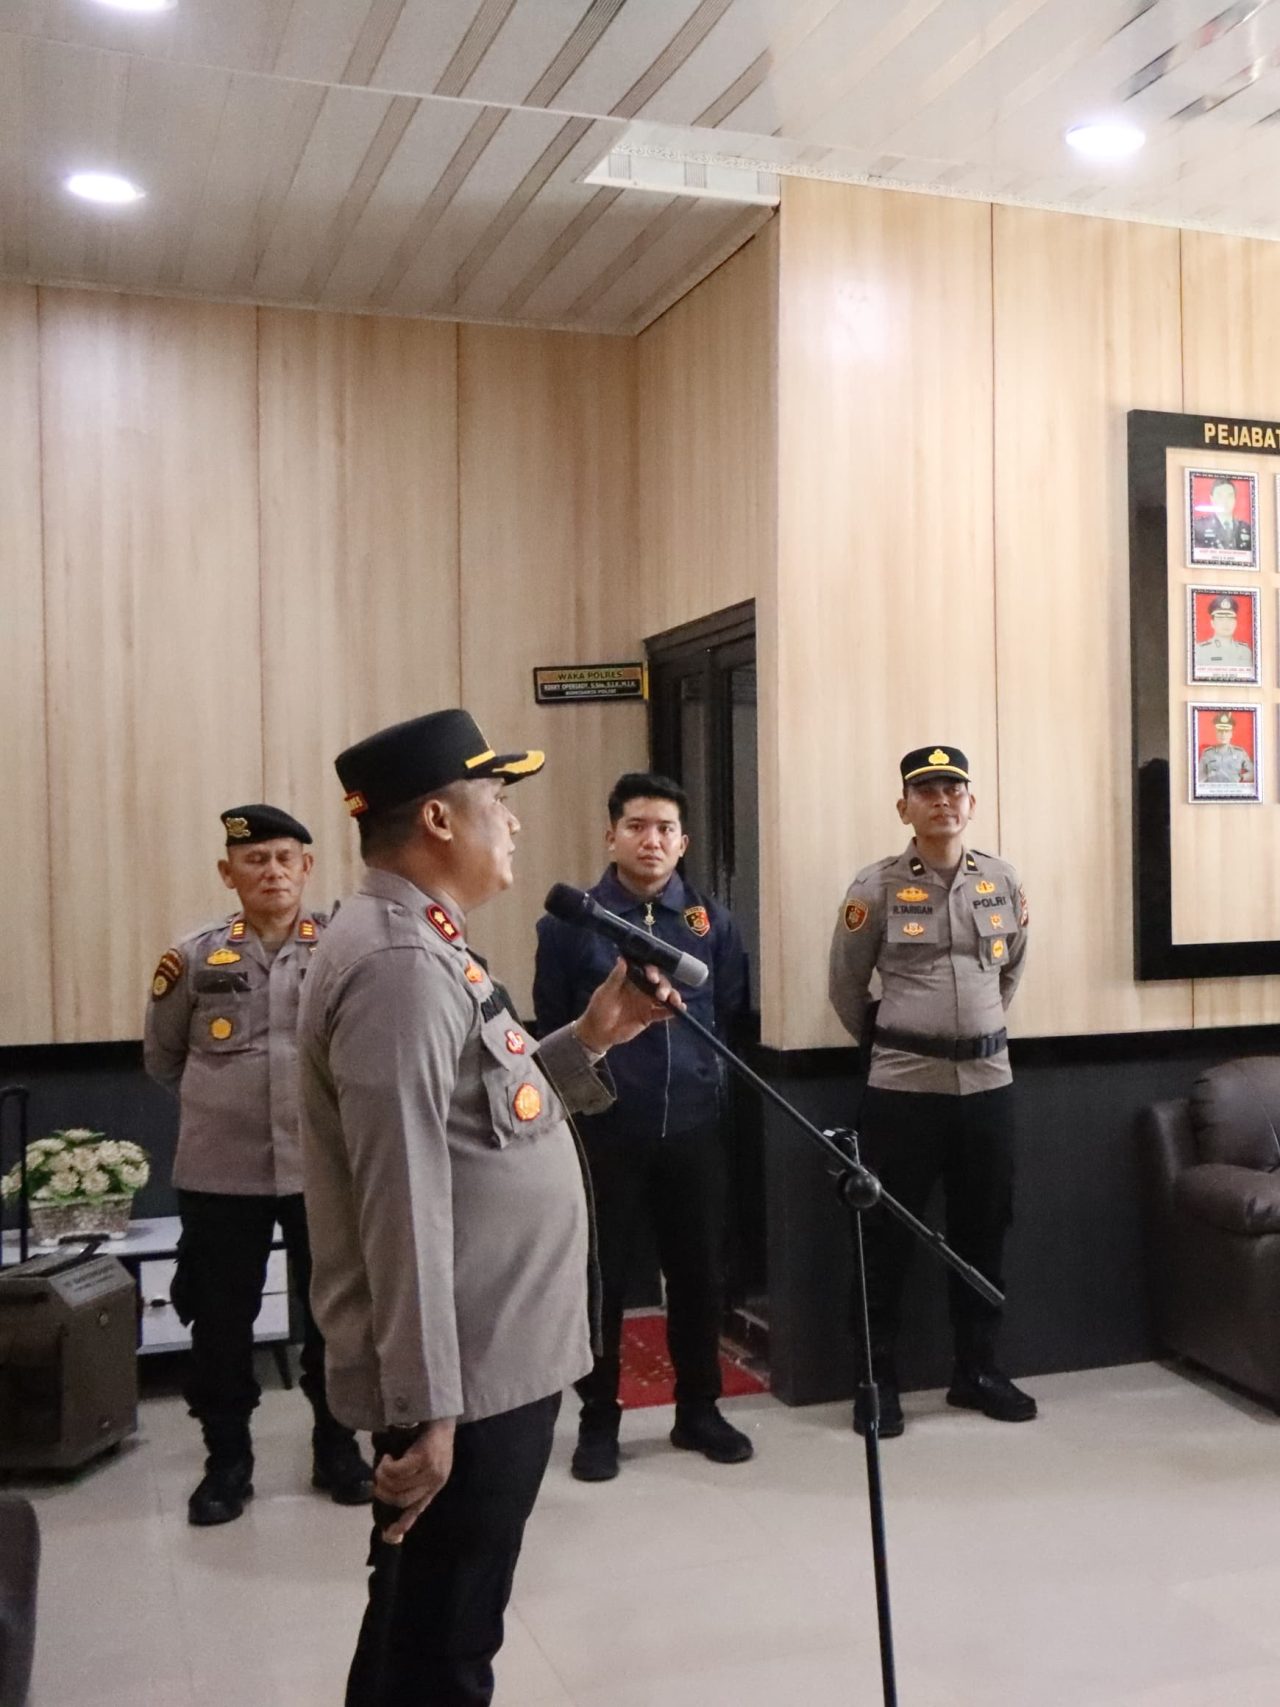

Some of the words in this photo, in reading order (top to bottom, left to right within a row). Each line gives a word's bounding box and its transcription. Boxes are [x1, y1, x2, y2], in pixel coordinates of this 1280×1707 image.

[558, 672, 585, 680] WAKA
[587, 671, 623, 679] POLRES
[973, 896, 1006, 909] POLRI
